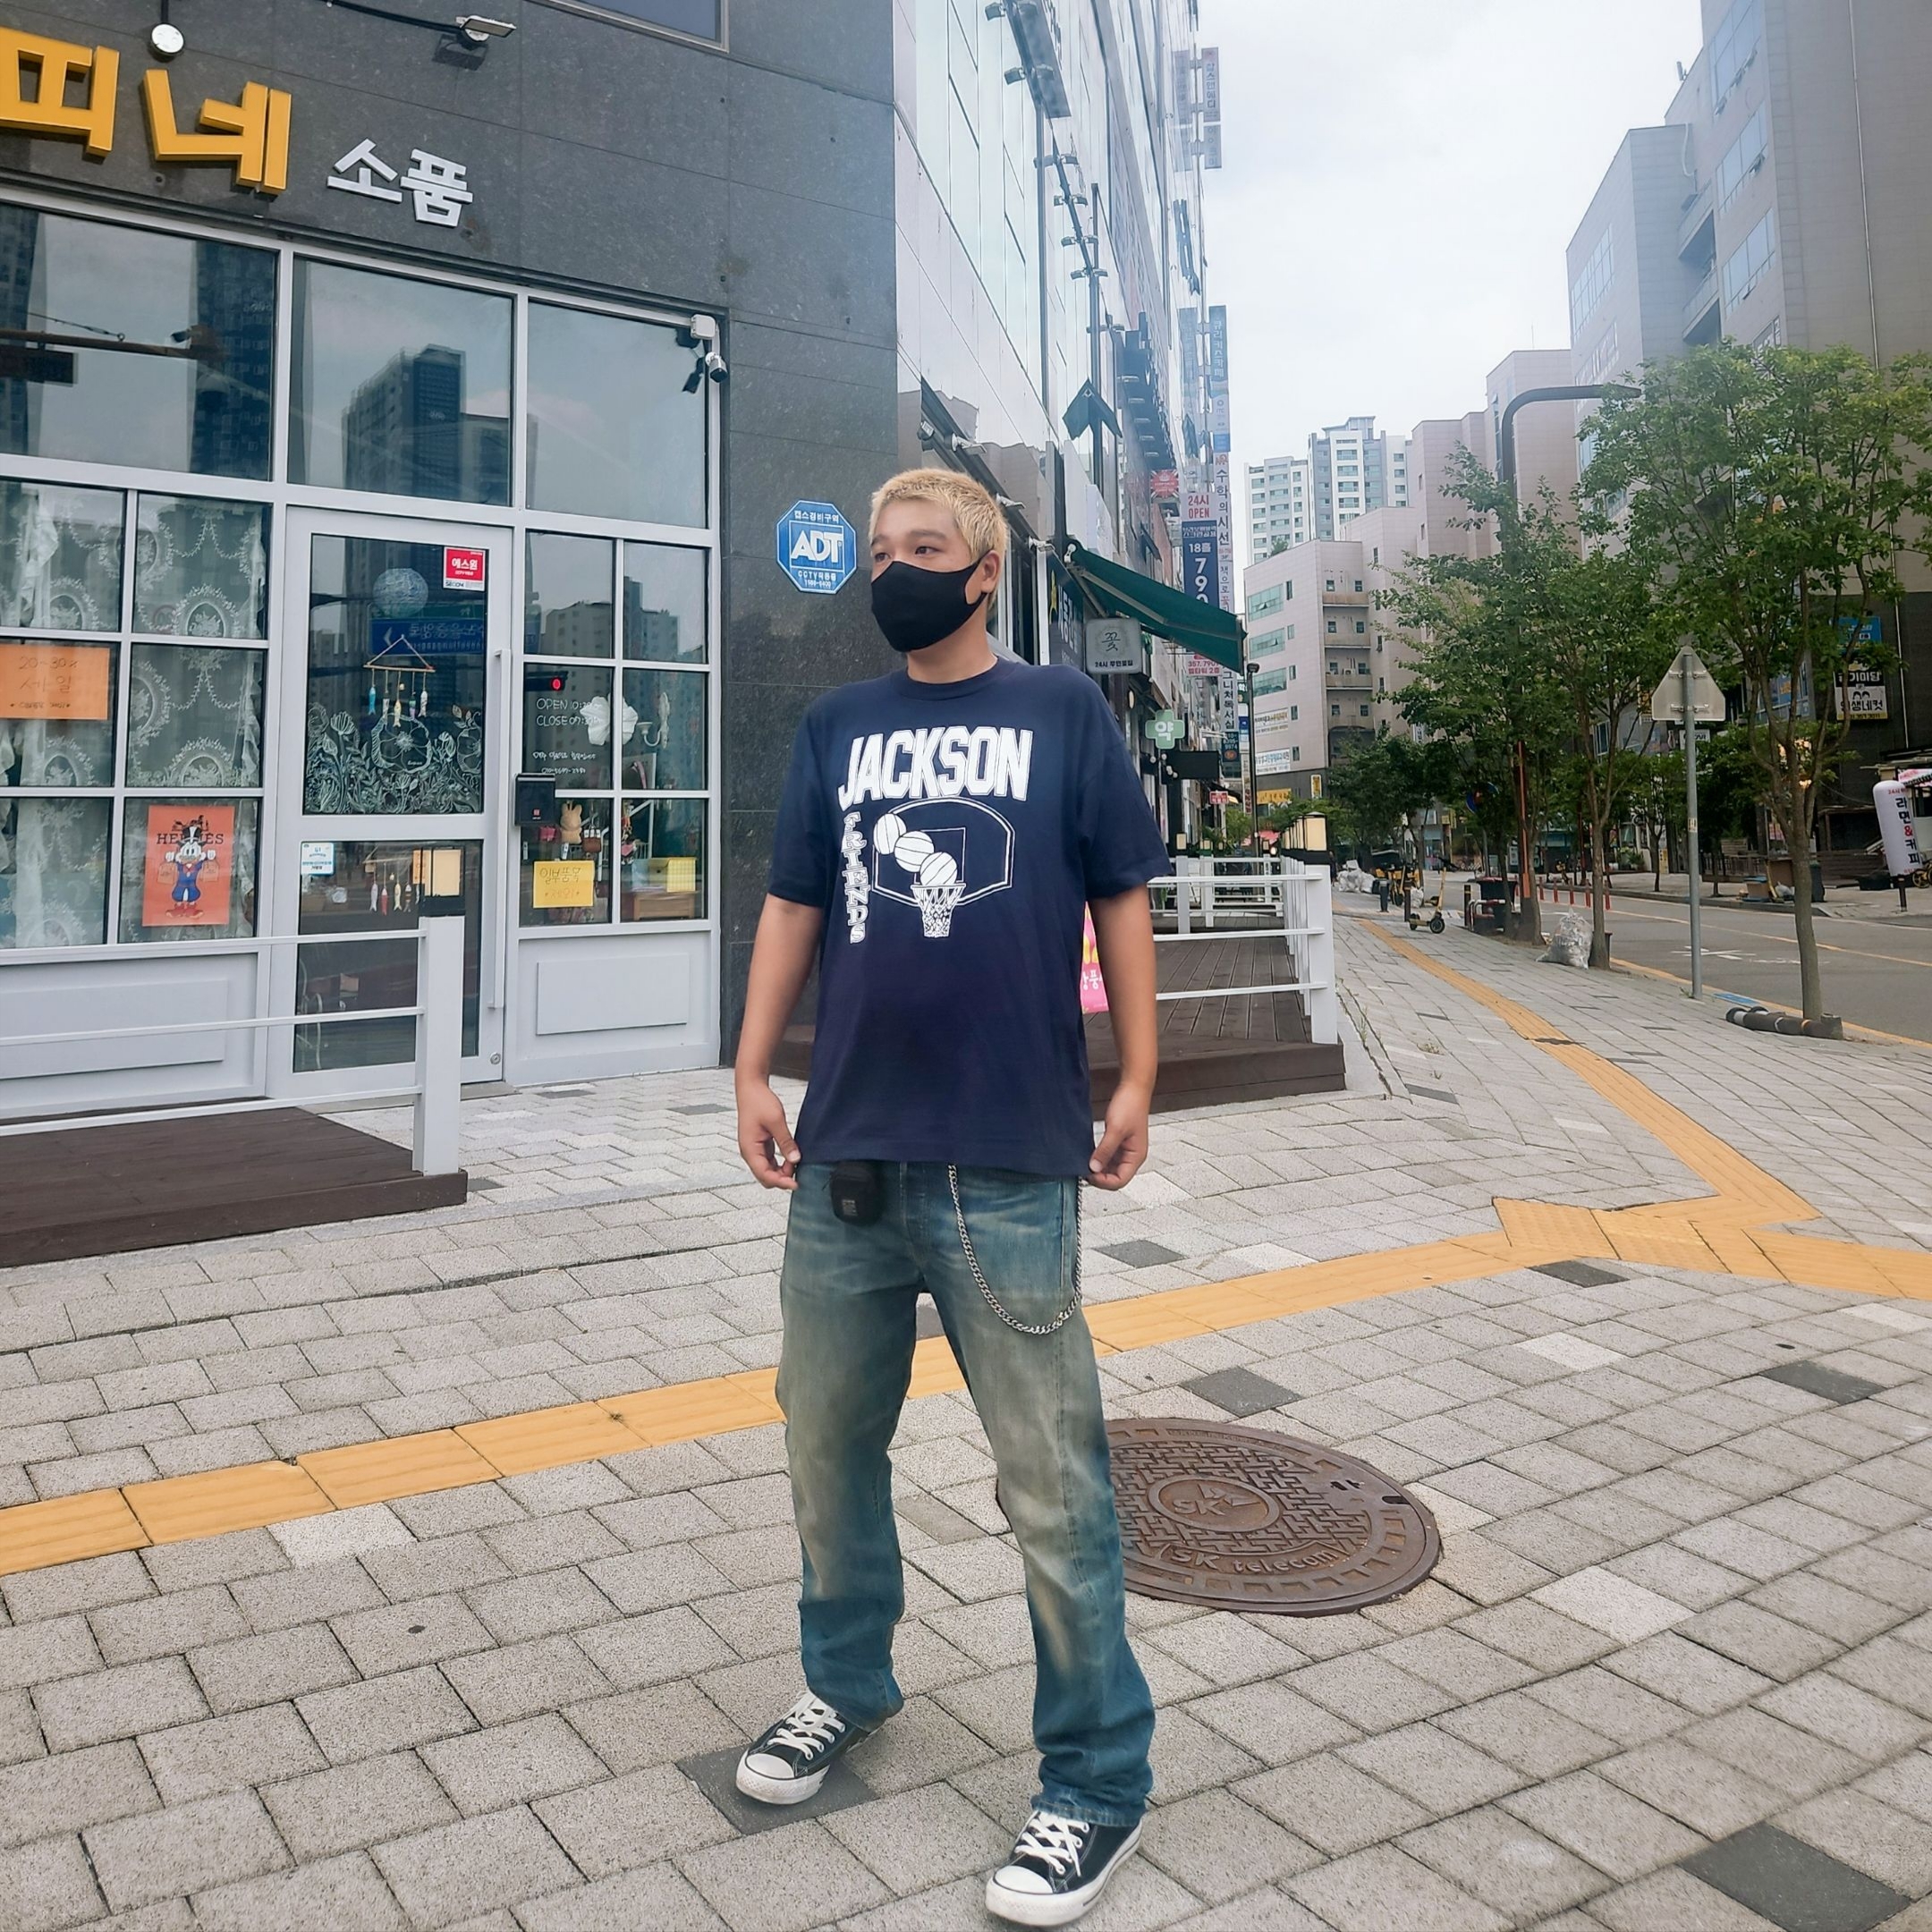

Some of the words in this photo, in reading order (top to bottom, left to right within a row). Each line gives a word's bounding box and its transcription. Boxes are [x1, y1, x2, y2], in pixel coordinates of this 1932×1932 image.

[327, 139, 473, 227] 소품
[1188, 495, 1209, 505] 24시
[1188, 507, 1209, 519] OPEN
[791, 530, 843, 564] ADT
[1102, 631, 1122, 652] 꽃
[537, 698, 568, 710] OPEN
[1221, 666, 1234, 730] 그니처독서실
[537, 715, 568, 726] CLOSE
[838, 725, 1033, 811] JACKSON
[841, 811, 871, 944] FRIENDS
[1174, 1499, 1224, 1517] SK
[1171, 1548, 1221, 1571] SK
[1233, 1547, 1338, 1572] telecom
